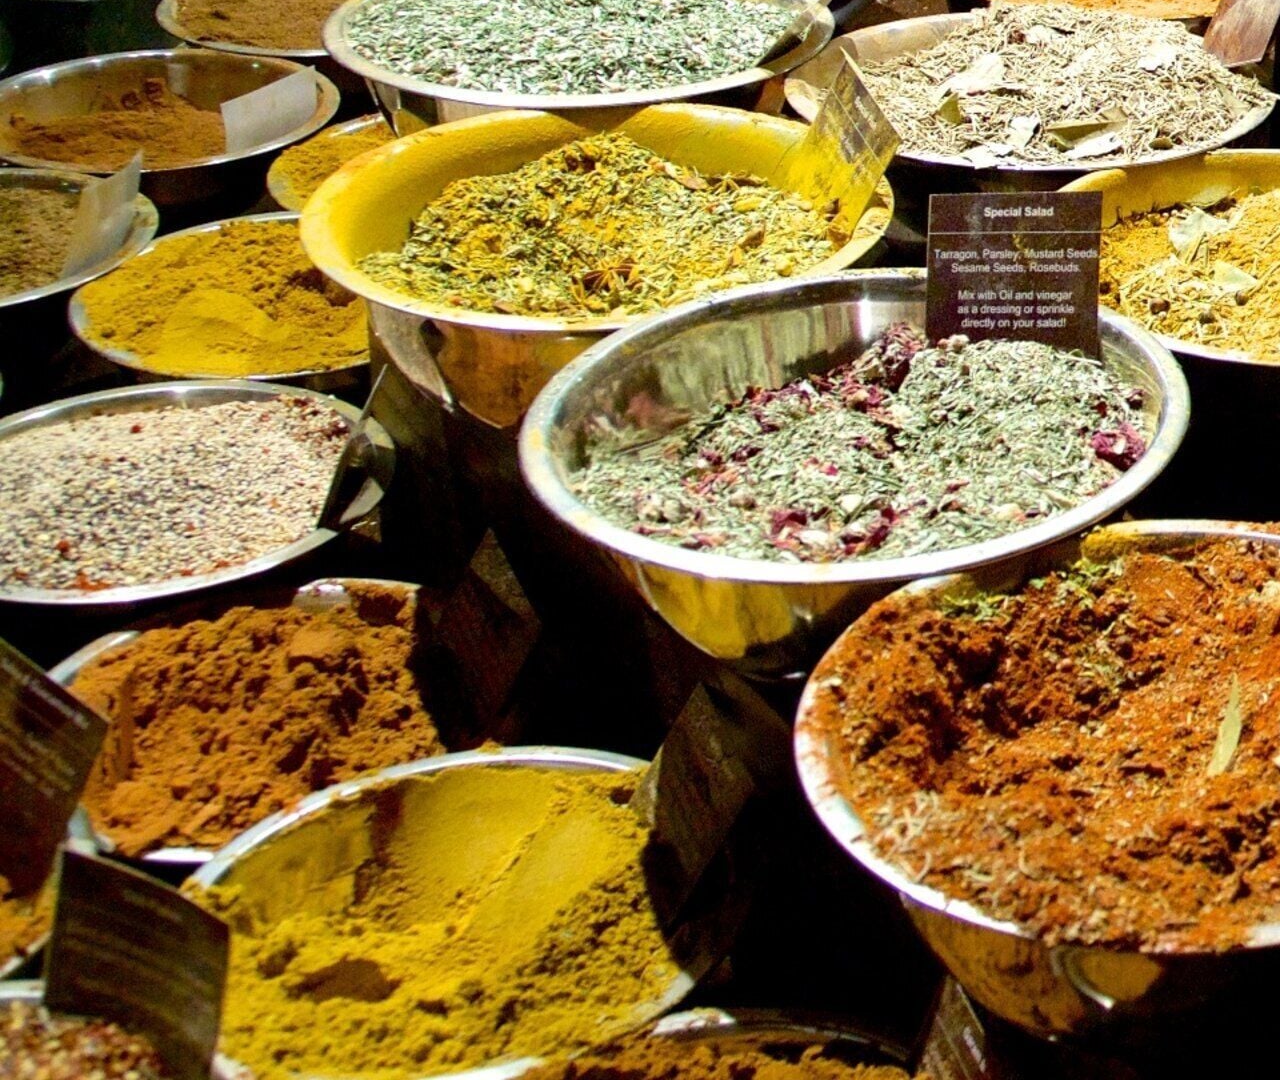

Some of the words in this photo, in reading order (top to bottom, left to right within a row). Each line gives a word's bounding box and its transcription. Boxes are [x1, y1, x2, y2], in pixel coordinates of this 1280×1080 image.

[983, 206, 1021, 218] Special
[1024, 206, 1054, 217] Salad
[1024, 248, 1064, 259] Mustard
[951, 263, 990, 273] Sesame
[958, 290, 974, 300] Mix
[977, 290, 996, 300] with
[999, 290, 1013, 300] Oil
[1015, 290, 1033, 300] and
[1036, 290, 1072, 302] vinegar
[957, 306, 969, 314] as
[980, 304, 1021, 316] dressing
[1023, 306, 1033, 314] or
[1036, 304, 1075, 316] sprinkle
[961, 317, 995, 329] directly
[997, 319, 1010, 328] on
[1012, 319, 1034, 330] your
[1036, 317, 1066, 328] salad!
